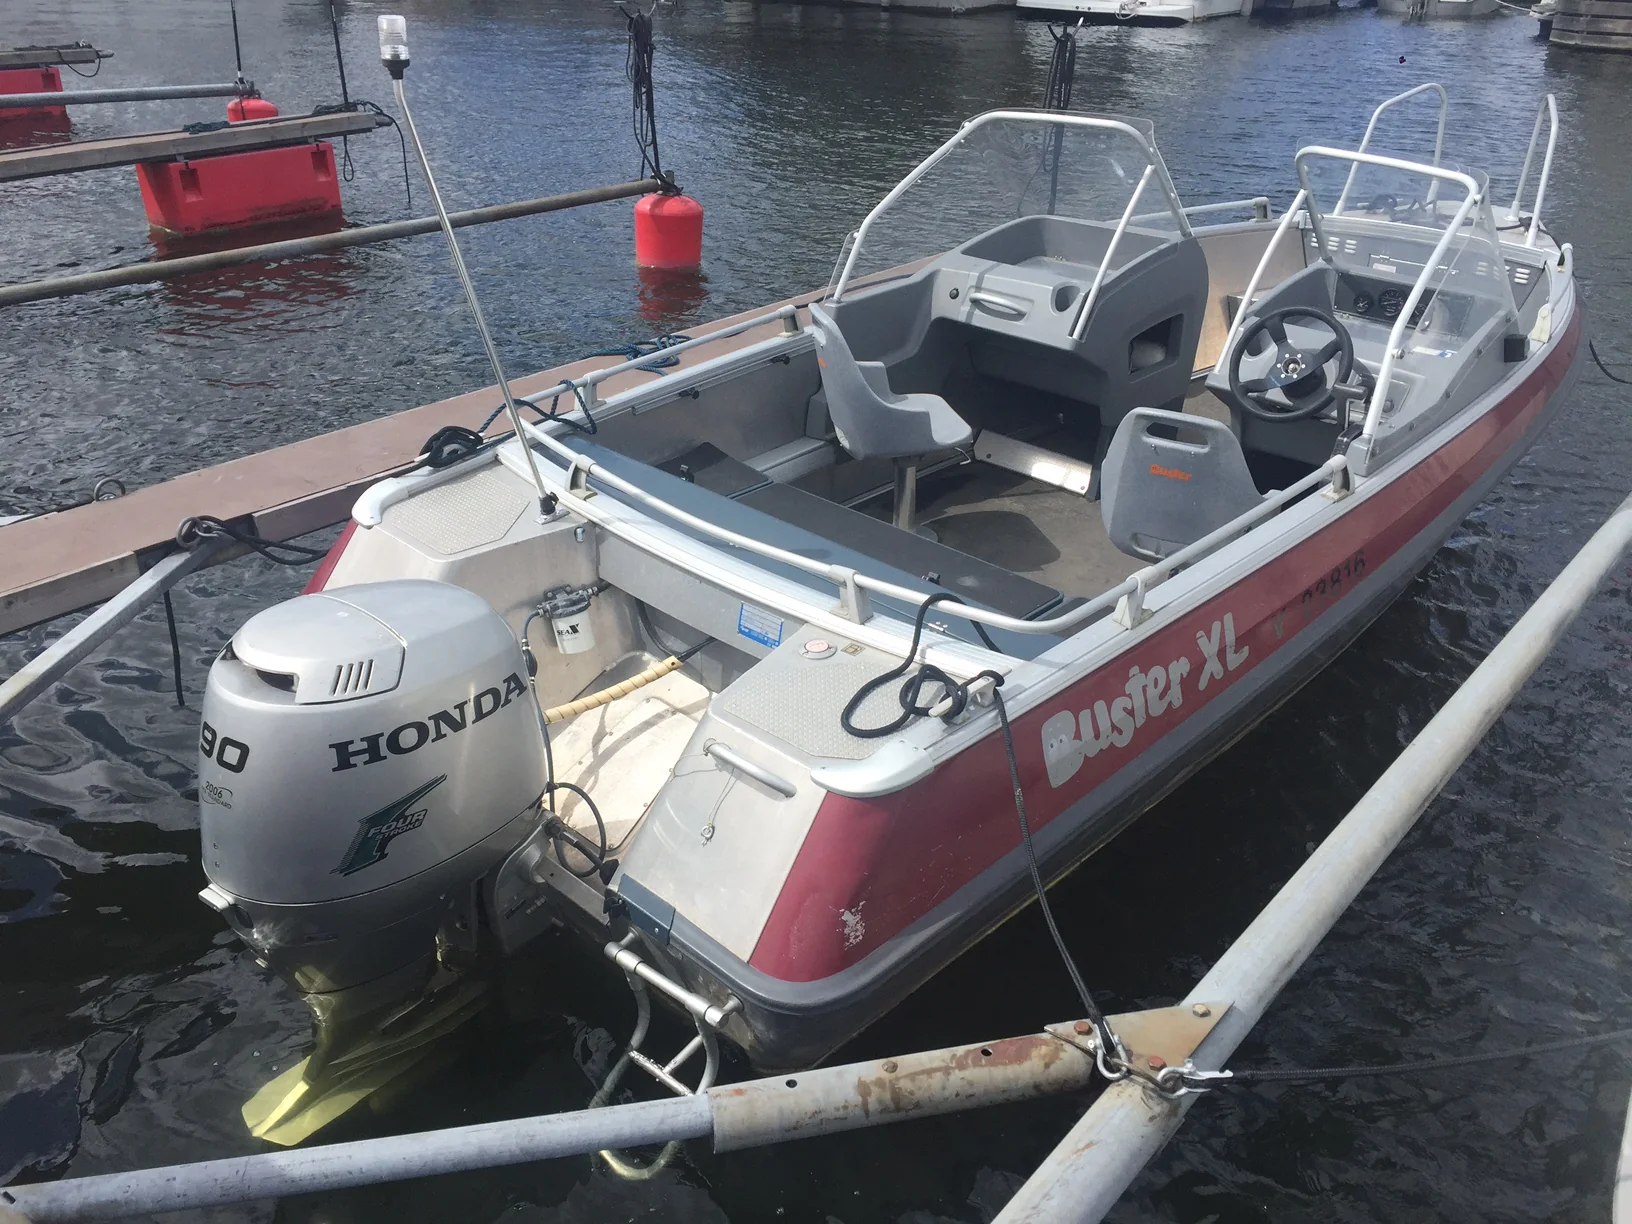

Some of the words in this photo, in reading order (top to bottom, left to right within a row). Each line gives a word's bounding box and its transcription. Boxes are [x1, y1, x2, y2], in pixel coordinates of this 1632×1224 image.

[1041, 656, 1190, 789] Buster
[1196, 612, 1250, 691] XL
[329, 672, 528, 772] HONDA
[200, 721, 250, 774] 90
[205, 780, 224, 799] 2006
[367, 811, 426, 838] FOUR
[374, 822, 421, 841] STROKE
